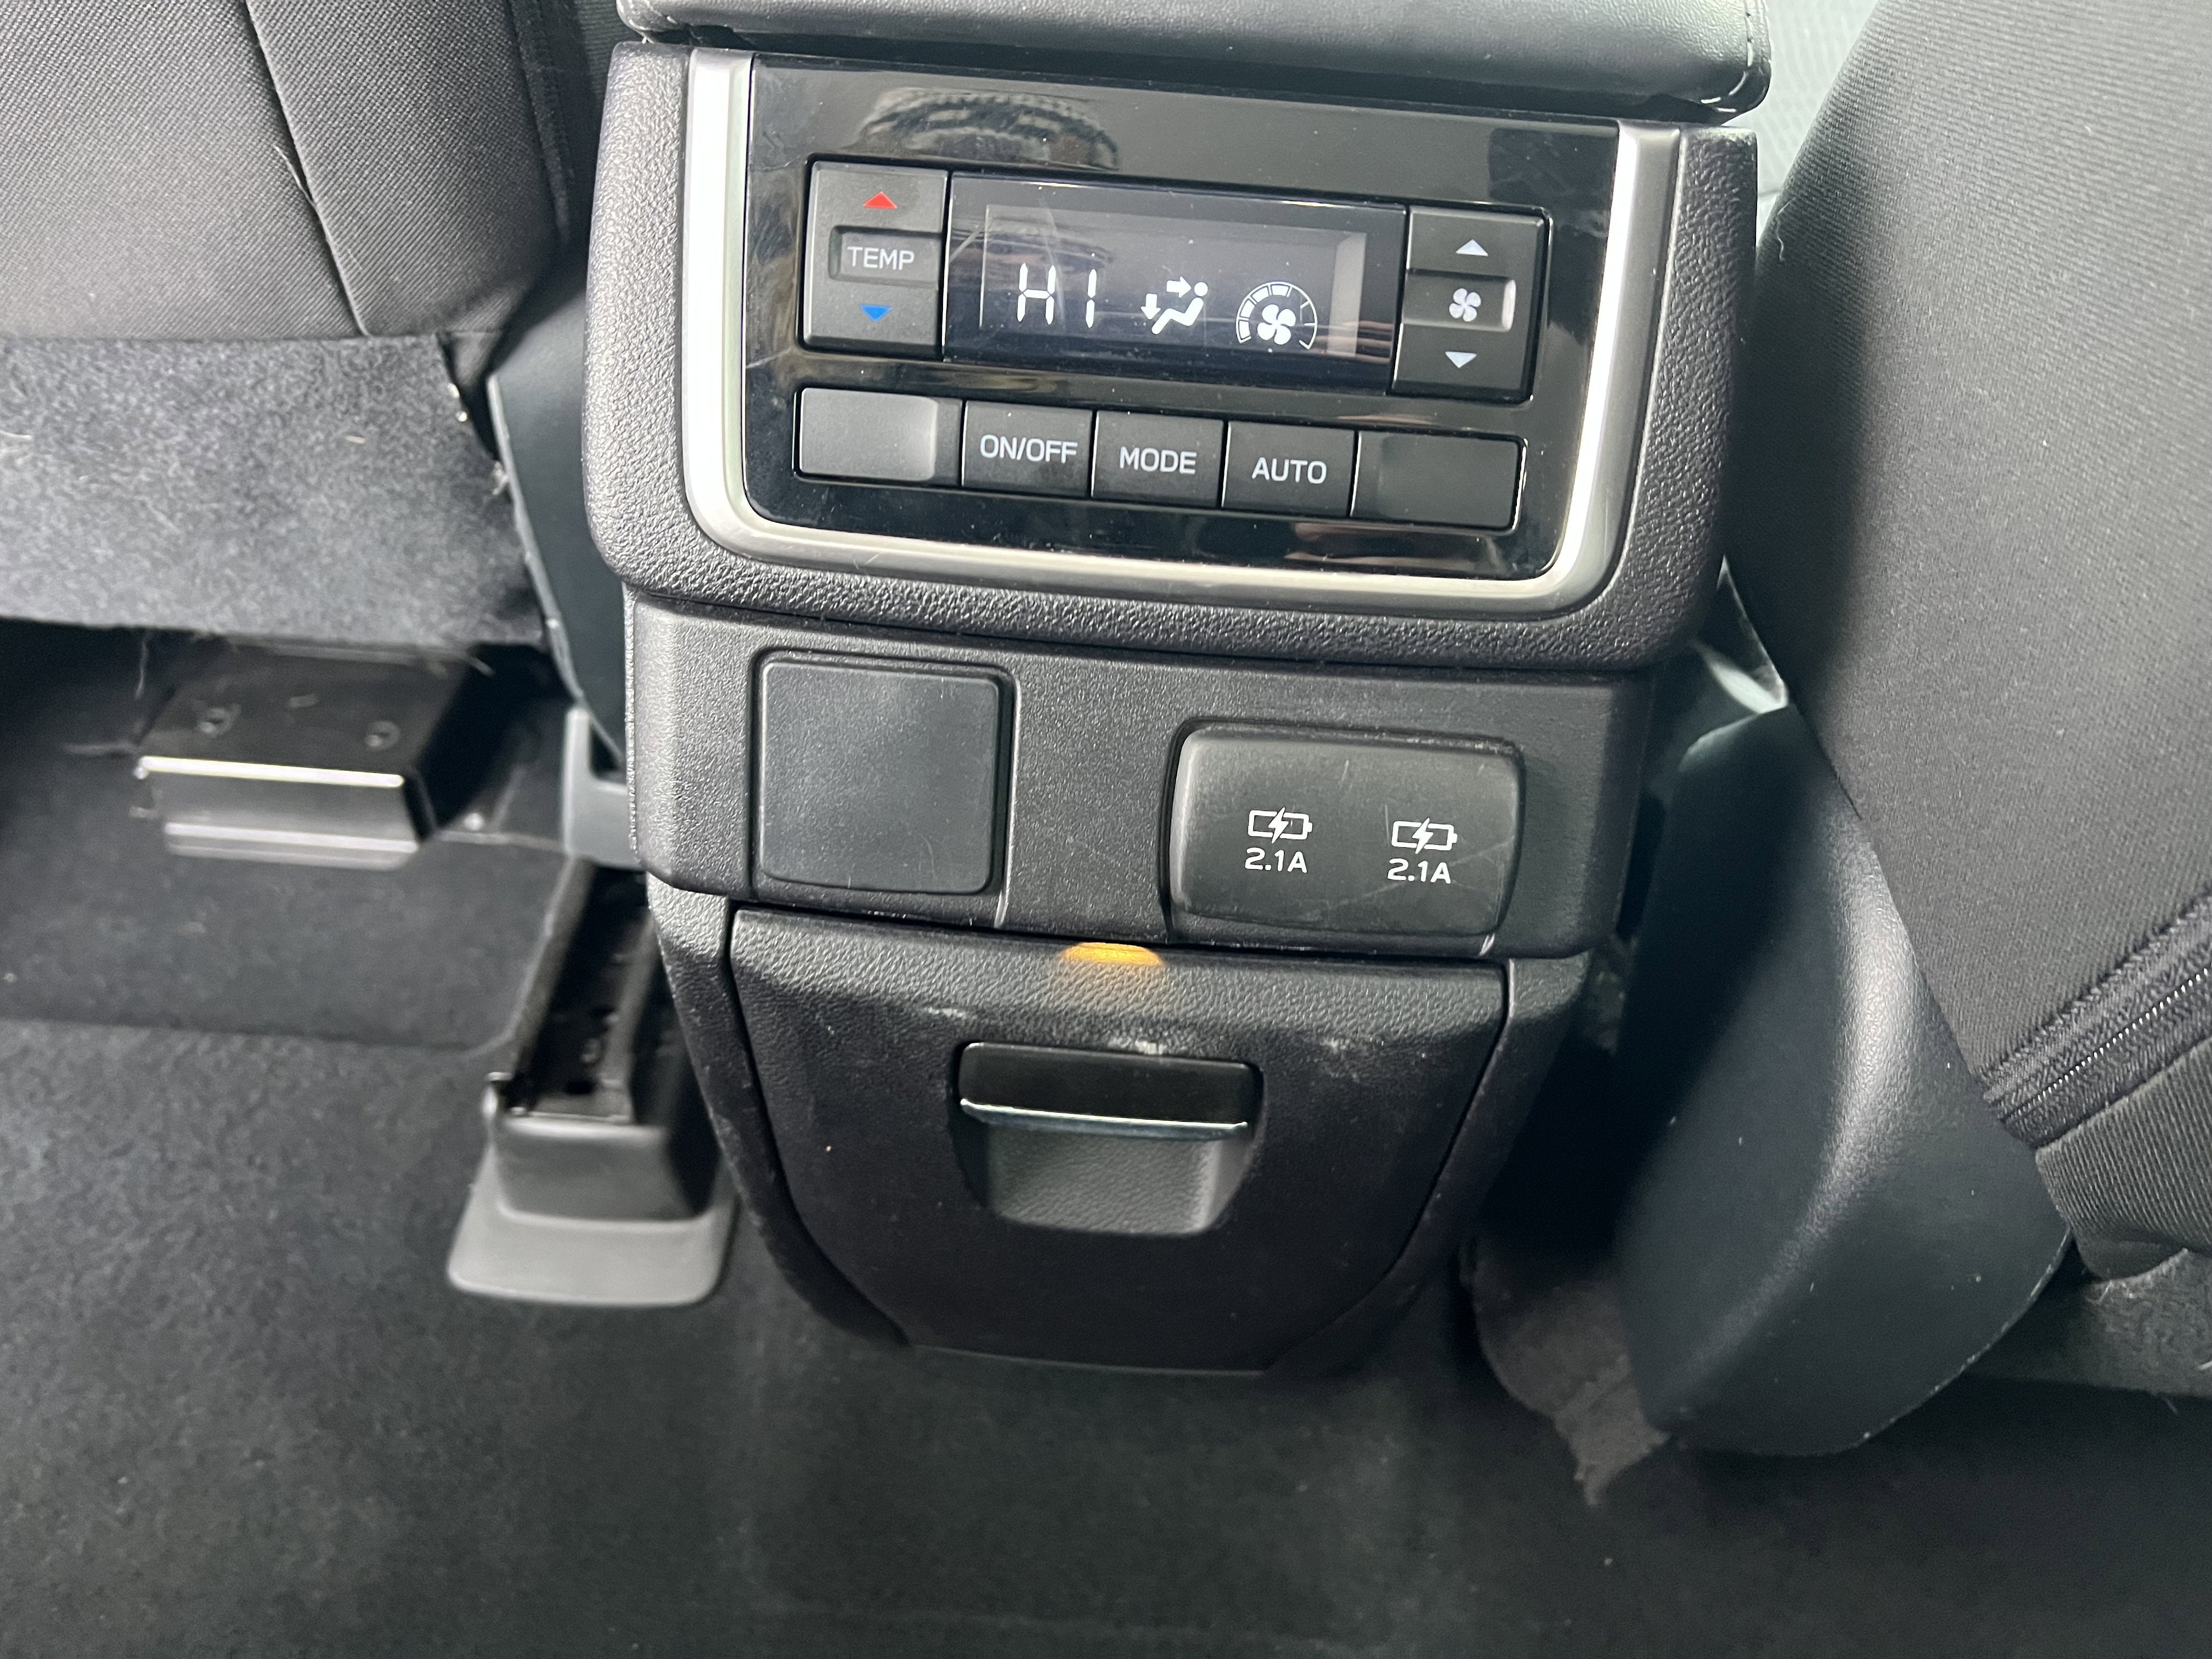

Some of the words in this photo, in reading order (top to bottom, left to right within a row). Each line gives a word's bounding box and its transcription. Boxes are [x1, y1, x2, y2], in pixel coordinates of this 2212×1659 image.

[848, 246, 915, 270] TEMP
[980, 434, 1078, 464] ON/OFF
[1119, 448, 1197, 474] MODE
[1251, 458, 1327, 484] AUTO
[1244, 847, 1307, 873] 2.1A
[1387, 858, 1451, 884] 2.1A
